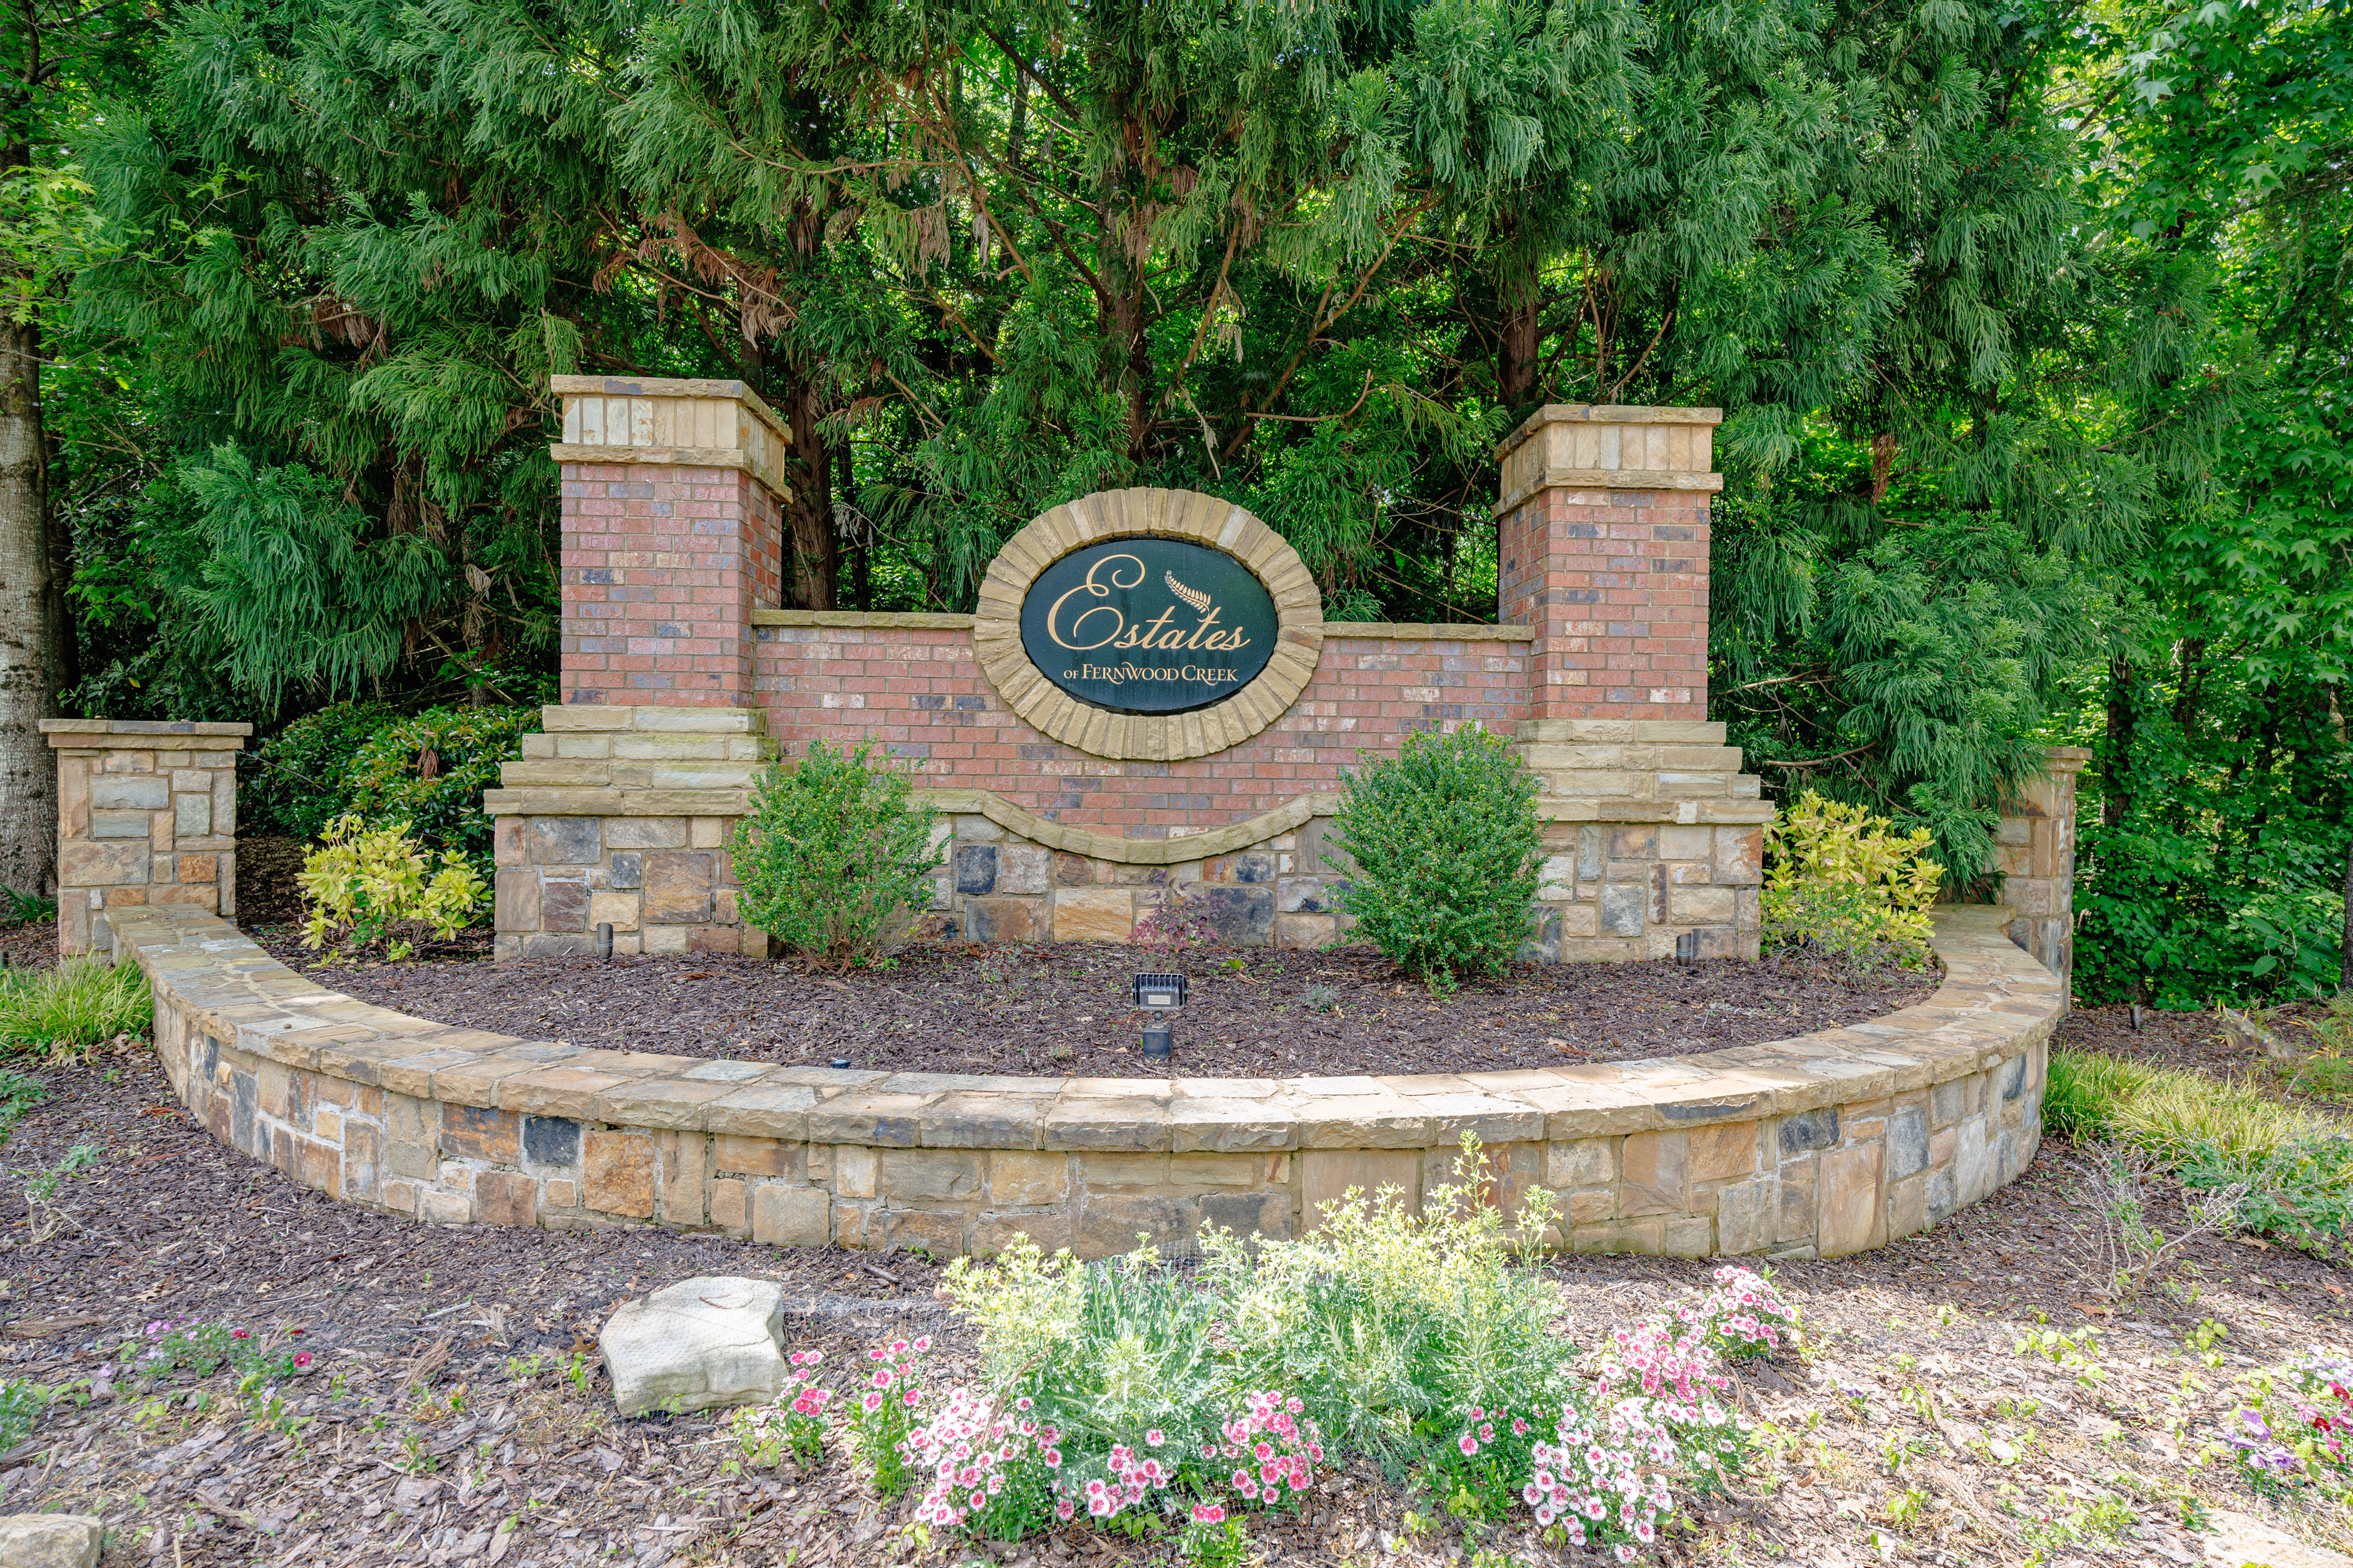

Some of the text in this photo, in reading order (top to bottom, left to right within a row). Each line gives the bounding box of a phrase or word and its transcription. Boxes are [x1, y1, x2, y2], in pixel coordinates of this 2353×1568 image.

[1047, 554, 1251, 650] Estates
[1064, 662, 1238, 686] OF FERNWOOD CREEK
